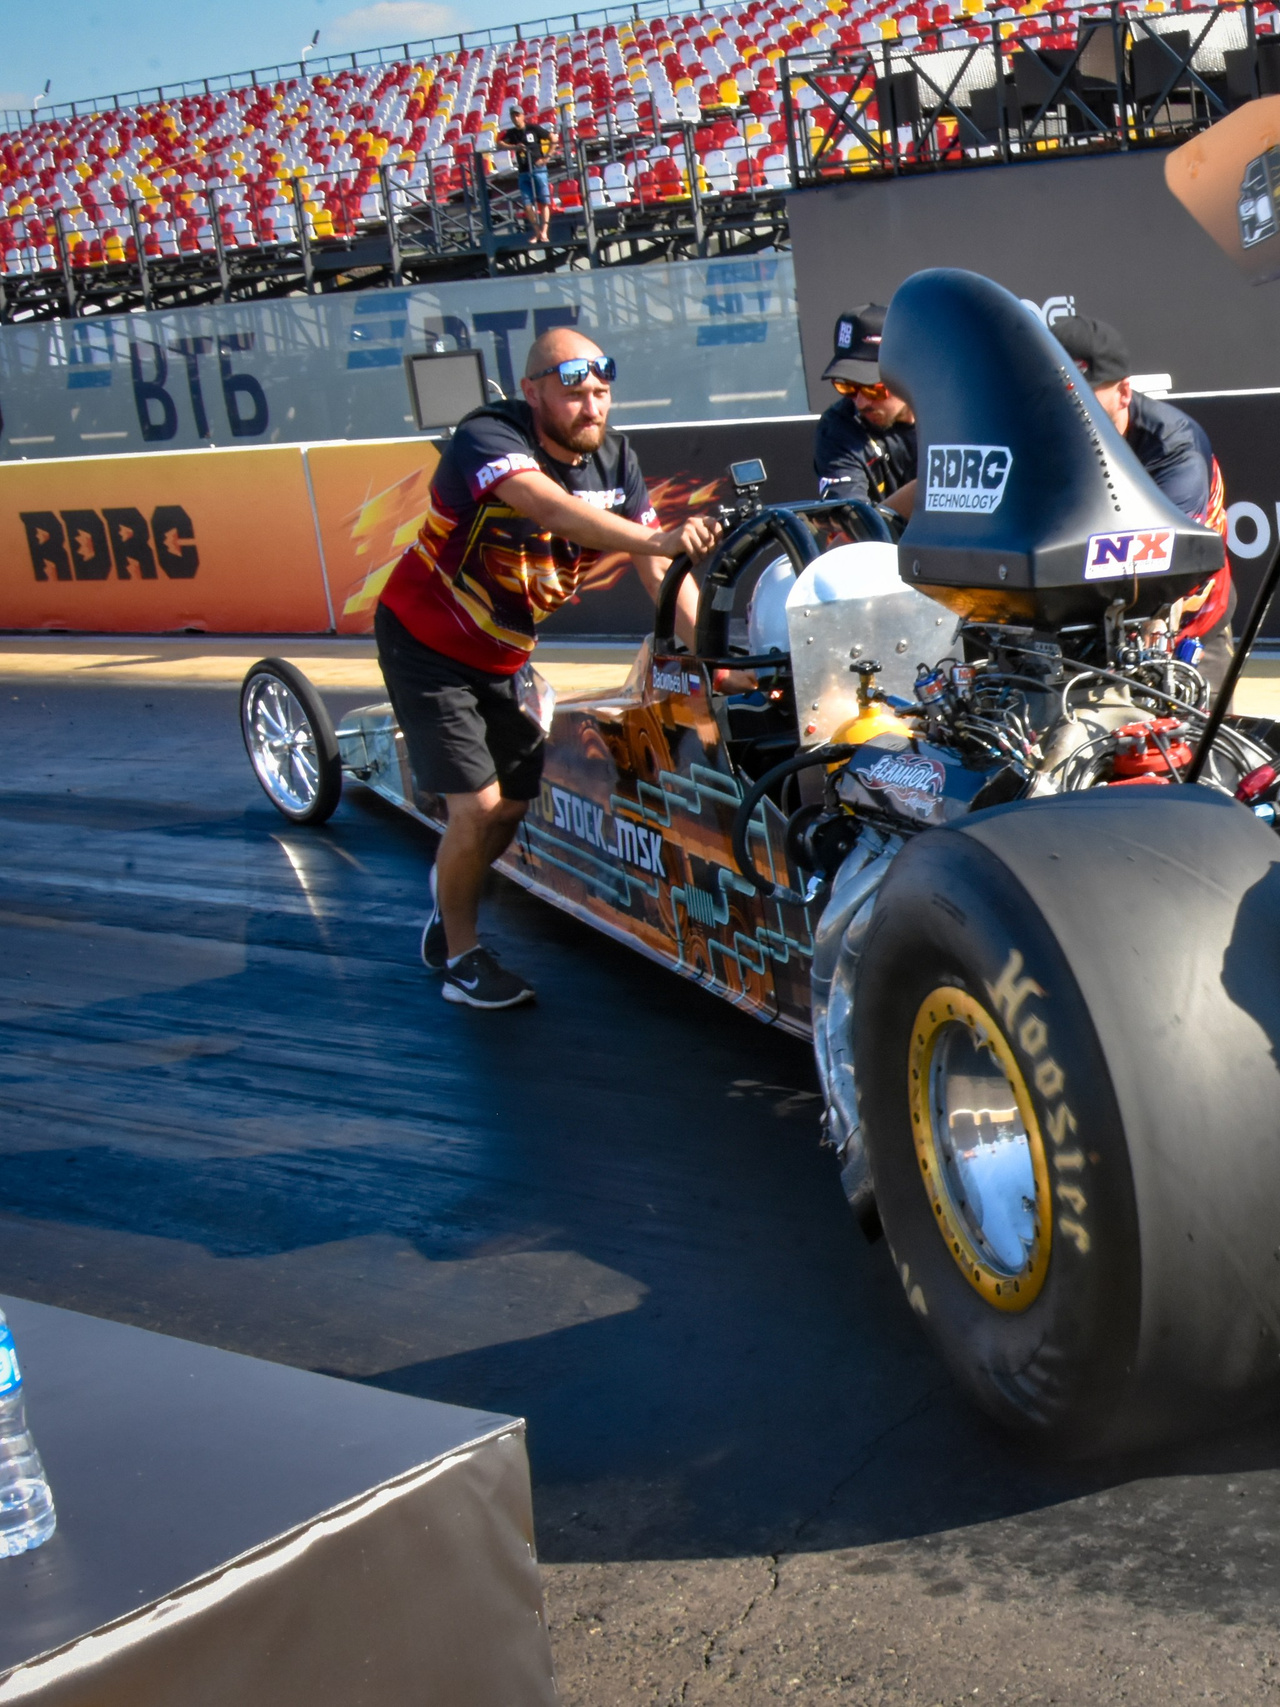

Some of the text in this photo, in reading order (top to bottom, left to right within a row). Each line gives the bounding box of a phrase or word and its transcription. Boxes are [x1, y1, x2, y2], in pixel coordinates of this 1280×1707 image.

[129, 332, 269, 442] ВТБ
[929, 449, 1008, 489] RDRC
[928, 493, 998, 509] TECHNOLOGY
[19, 505, 199, 581] RDRC
[1091, 532, 1170, 566] NX
